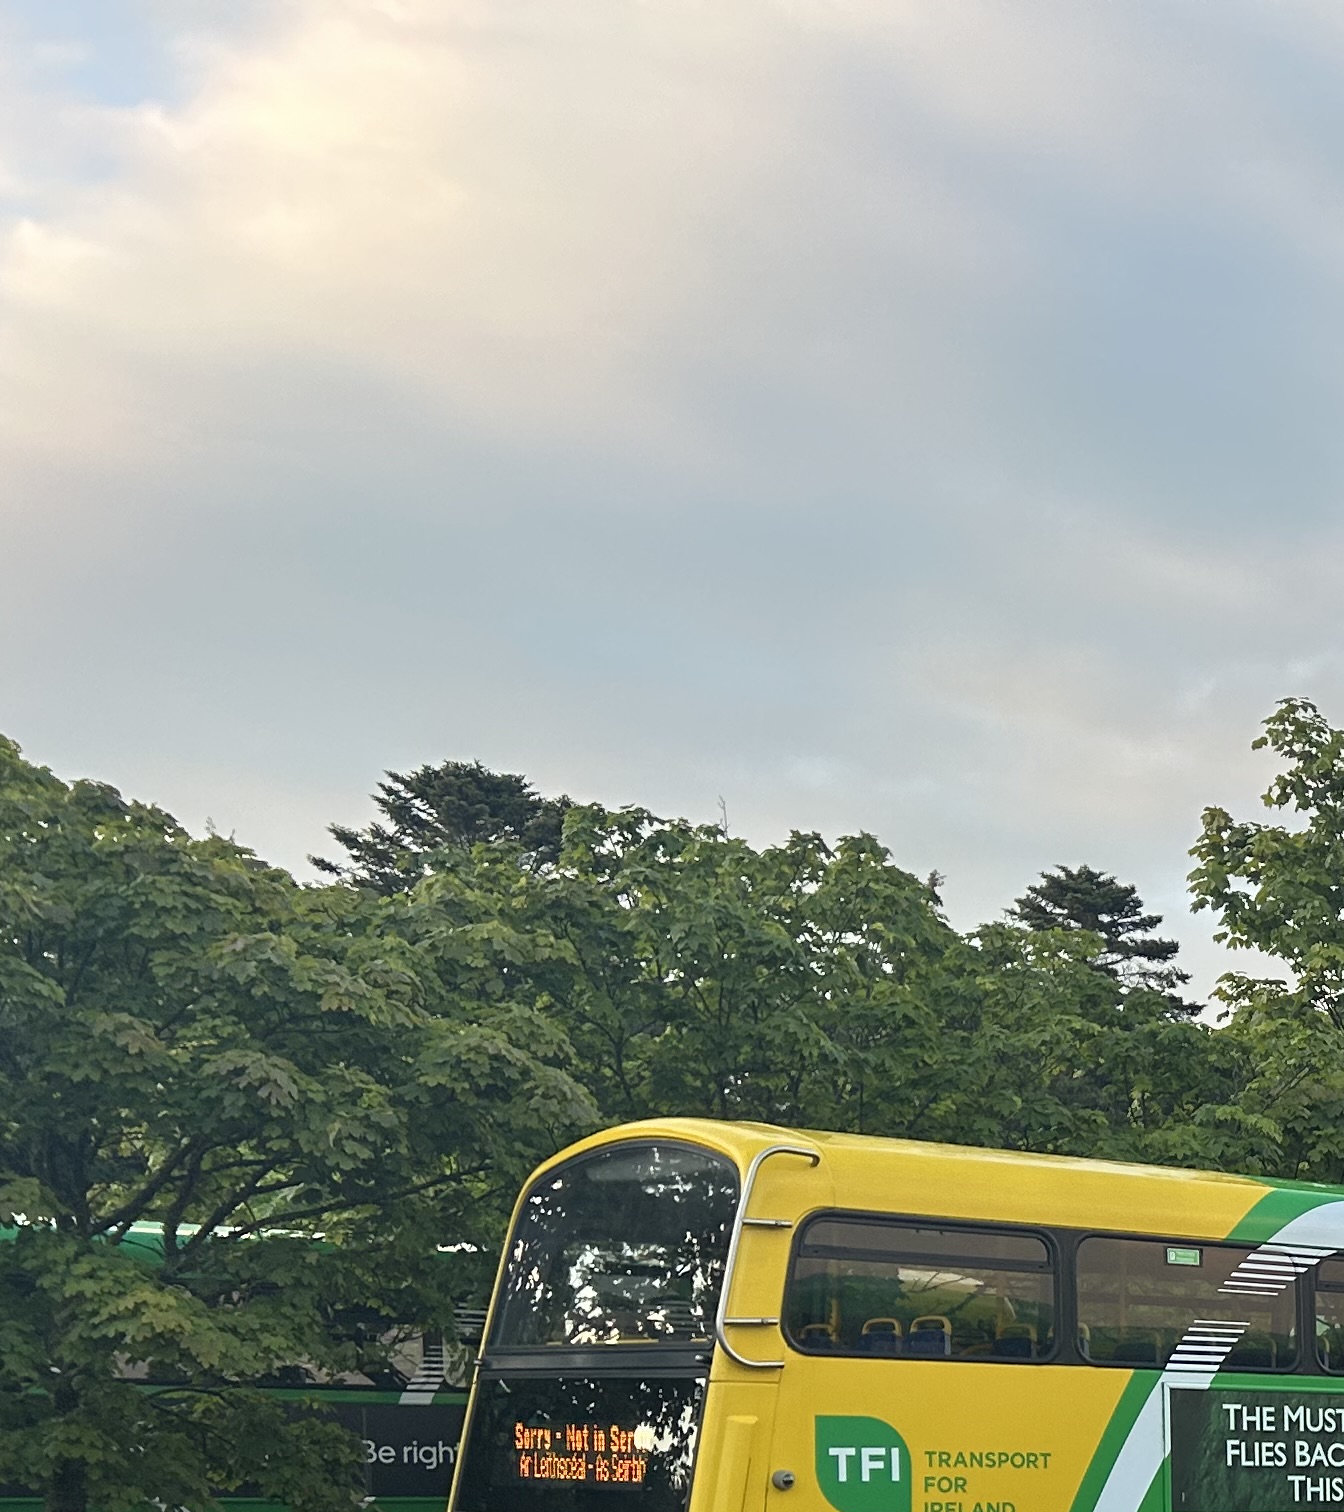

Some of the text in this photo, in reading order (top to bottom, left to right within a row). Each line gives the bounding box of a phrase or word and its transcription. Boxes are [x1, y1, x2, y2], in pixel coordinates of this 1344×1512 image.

[1222, 1404, 1275, 1432] THE
[515, 1422, 551, 1450] Sorry
[566, 1423, 589, 1452] Not
[594, 1423, 606, 1452] in
[828, 1446, 900, 1483] TFI
[924, 1450, 1051, 1469] TRANSPORT
[1226, 1440, 1286, 1467] FLIES
[924, 1476, 967, 1493] FOR
[1287, 1475, 1344, 1502] THIS
